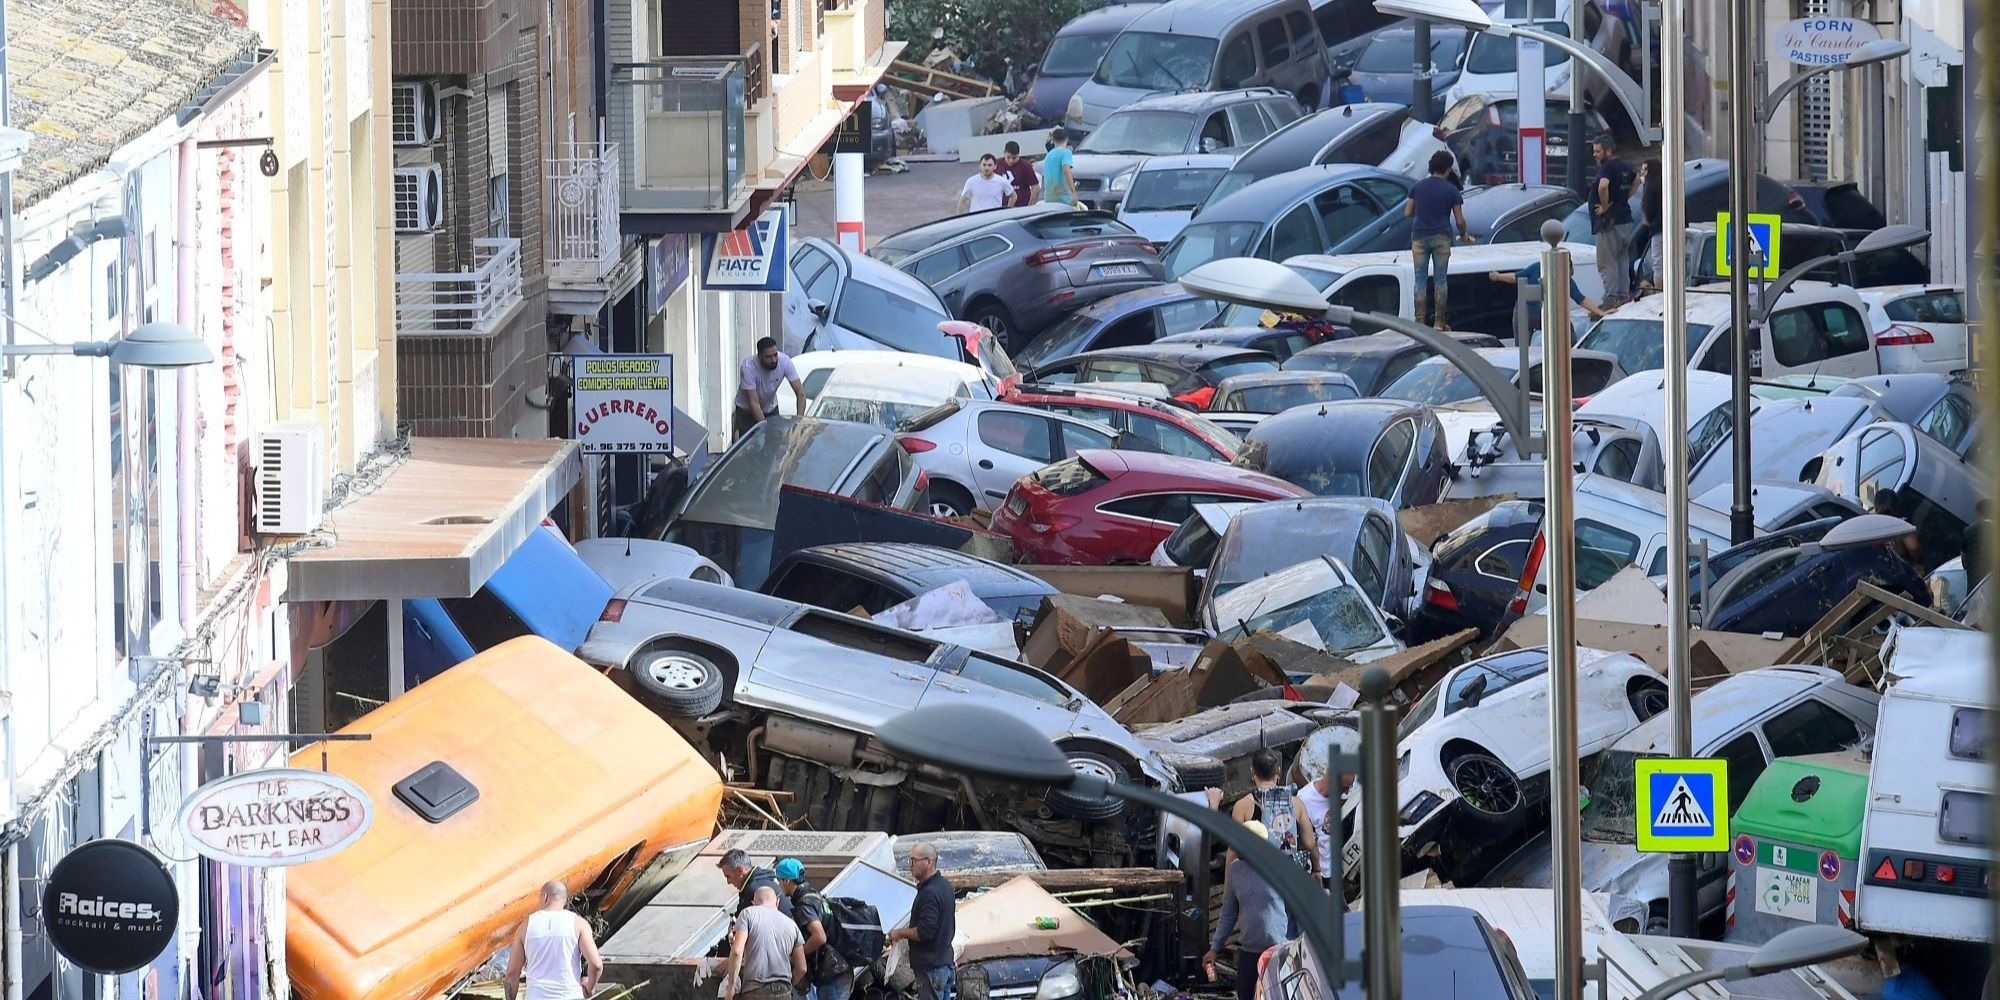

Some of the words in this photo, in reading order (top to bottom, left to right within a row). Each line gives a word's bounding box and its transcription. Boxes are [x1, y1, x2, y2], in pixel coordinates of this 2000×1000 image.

[1803, 20, 1854, 33] FORN
[717, 258, 762, 271] FIATC
[585, 360, 617, 374] POLLOS
[618, 360, 651, 373] ASADOS
[651, 360, 660, 373] Y
[577, 377, 613, 391] COMIDAS
[614, 377, 637, 390] PARA
[637, 376, 669, 390] LLEVAR
[577, 399, 669, 436] GUERRERO
[600, 443, 613, 451] 96
[616, 443, 636, 451] 375
[639, 443, 652, 451] 70
[656, 443, 669, 451] 76
[257, 778, 289, 797] PUB
[200, 797, 351, 831] DARKNESS
[226, 831, 281, 850] METAL
[288, 828, 323, 847] BAR
[1785, 874, 1811, 885] ALFAFAR
[59, 892, 154, 919] Raices
[1793, 894, 1810, 904] TOTS
[58, 918, 106, 930] cocktail
[113, 923, 120, 931] &
[127, 923, 162, 931] music
